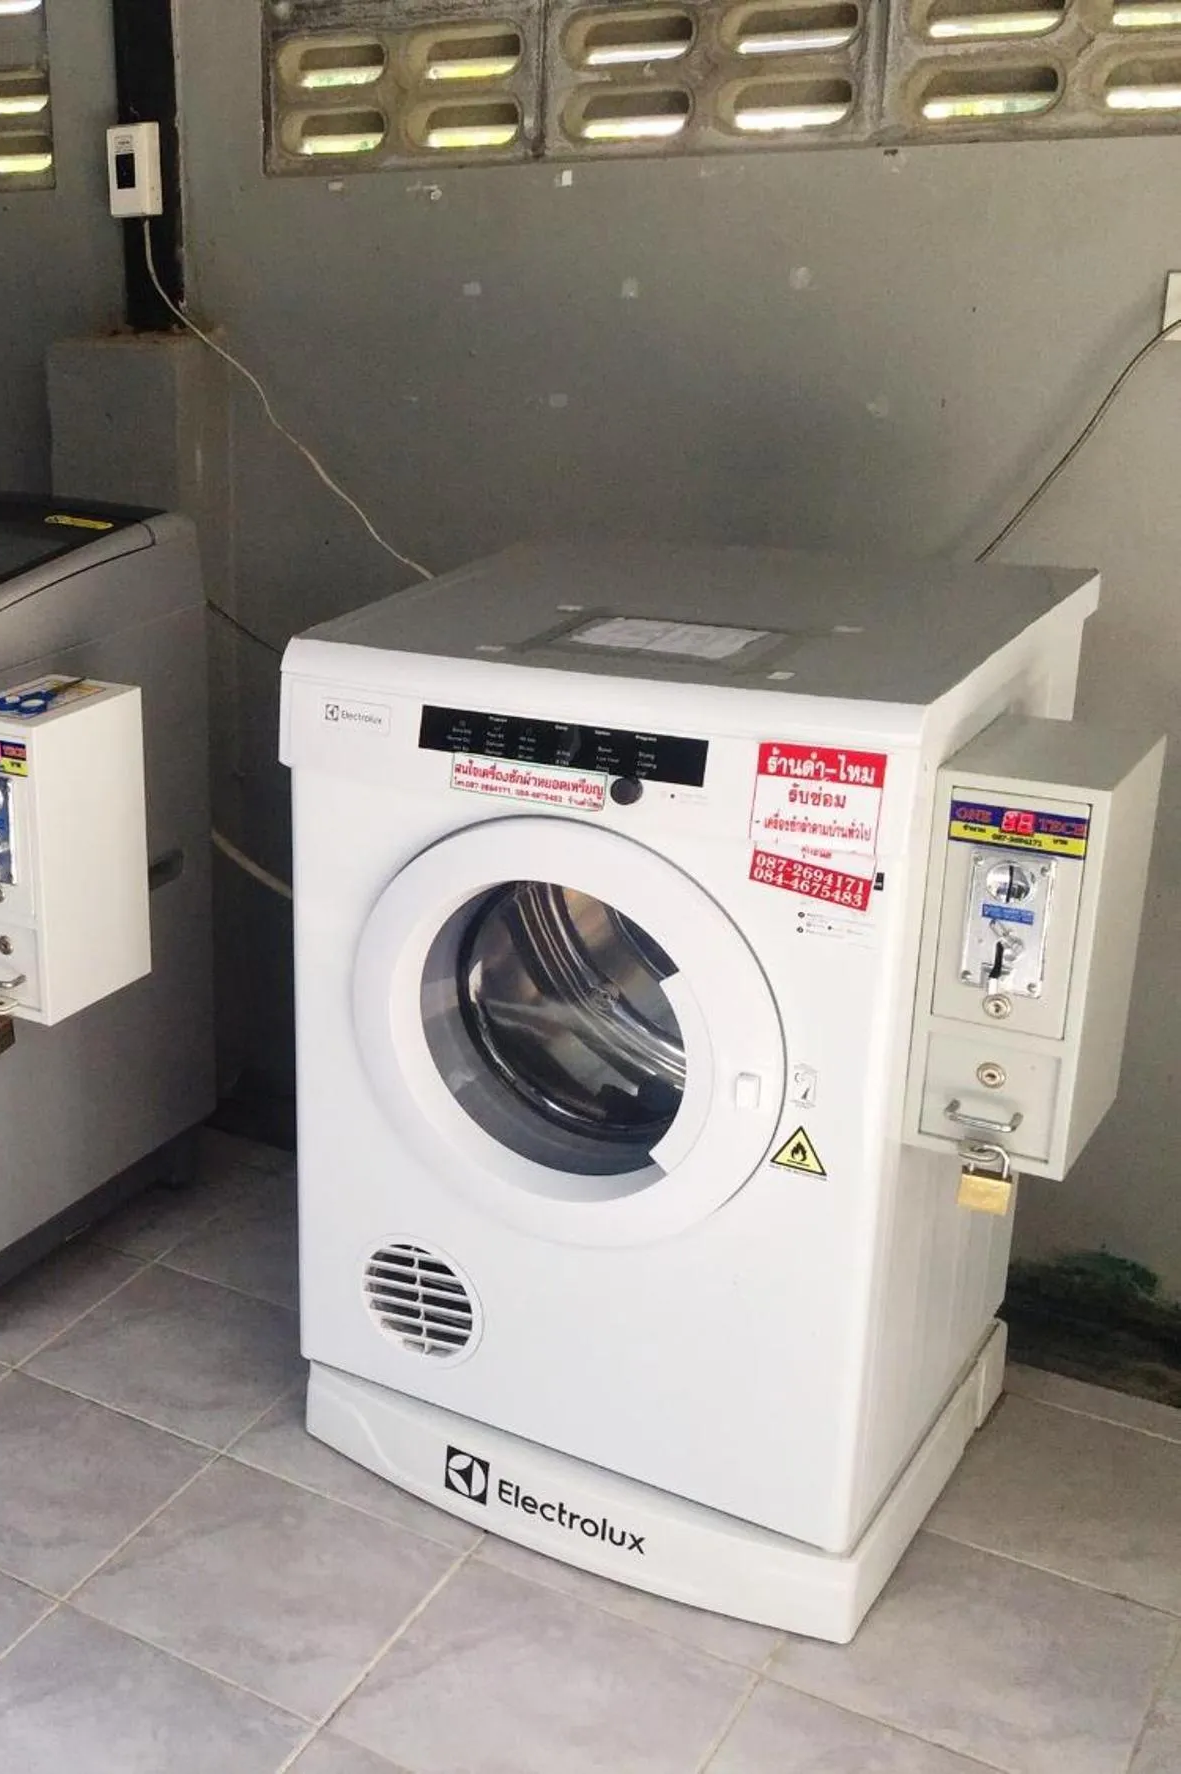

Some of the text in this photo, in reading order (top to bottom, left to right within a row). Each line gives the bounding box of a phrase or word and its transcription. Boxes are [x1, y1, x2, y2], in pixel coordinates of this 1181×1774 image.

[767, 747, 876, 785] ร้านดำ-ไหม
[787, 782, 847, 809] รับซ่อม
[752, 867, 864, 908] 084-4675483
[755, 853, 866, 895] 087-2694171
[497, 1478, 646, 1555] Electrolux
